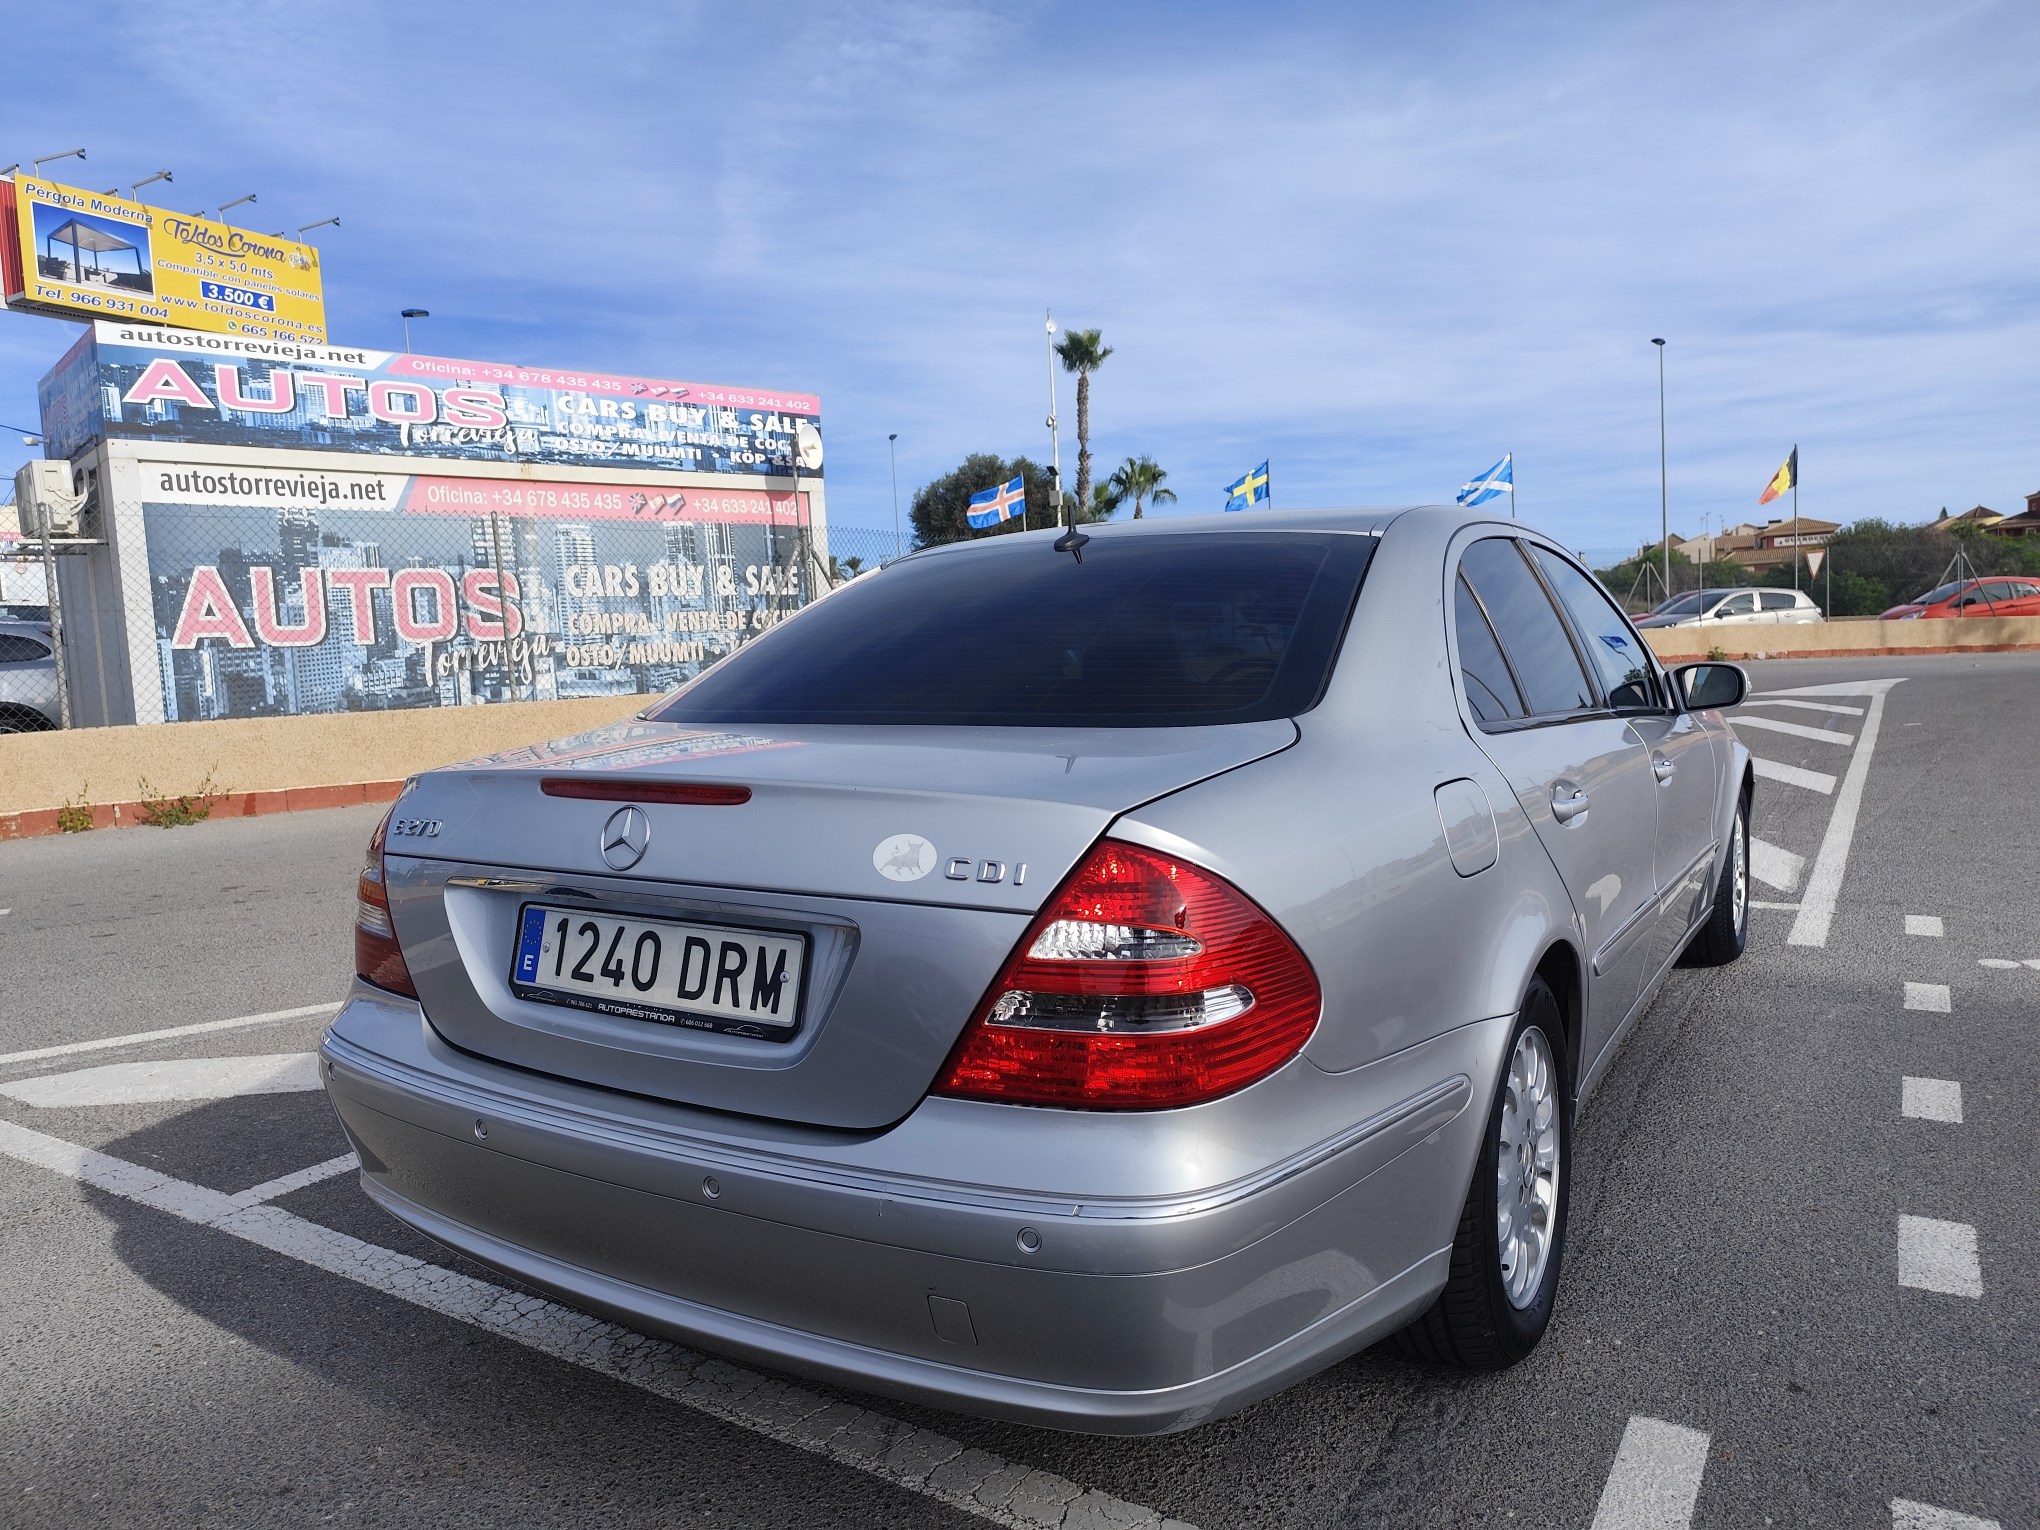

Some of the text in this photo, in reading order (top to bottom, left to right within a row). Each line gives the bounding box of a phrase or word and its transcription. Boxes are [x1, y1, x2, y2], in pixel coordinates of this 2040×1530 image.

[25, 183, 153, 223] Pérgola Moderna
[164, 217, 286, 263] Toldos Corona
[157, 259, 320, 301] Compatible con paneles solares
[195, 252, 214, 266] 3,5
[229, 260, 247, 273] 5,0
[251, 267, 277, 279] mts.
[34, 285, 169, 319] Tel. 966 931 004
[208, 284, 270, 309] 3.500 €
[161, 294, 323, 334] www.toldoscorona.es
[120, 328, 367, 366] autostorrevieja.net
[241, 324, 267, 337] 665
[272, 329, 296, 342] 166
[412, 360, 622, 391] Oficina: +34 678 435 435
[121, 357, 509, 430] AUTOS
[698, 391, 810, 411] +34 633 241 402
[557, 396, 637, 420] CARS
[648, 403, 708, 425] BUY
[720, 411, 740, 429] &
[400, 421, 538, 455] Torrevieja
[728, 435, 749, 449] DE
[730, 450, 765, 465] KÖP
[160, 471, 386, 504] autostorrevieja.net
[428, 485, 622, 510] Oficina: +34 678 435 435
[693, 498, 798, 515] +34 633 241 402
[566, 564, 799, 597] CARS BUY & SALE
[171, 566, 523, 650] AUTOS
[726, 610, 747, 630] DE
[944, 856, 1028, 886] CDI
[523, 954, 534, 971] E
[555, 918, 787, 1014] 1240 DRM
[597, 1003, 676, 1023] AUTOPRESTANDA
